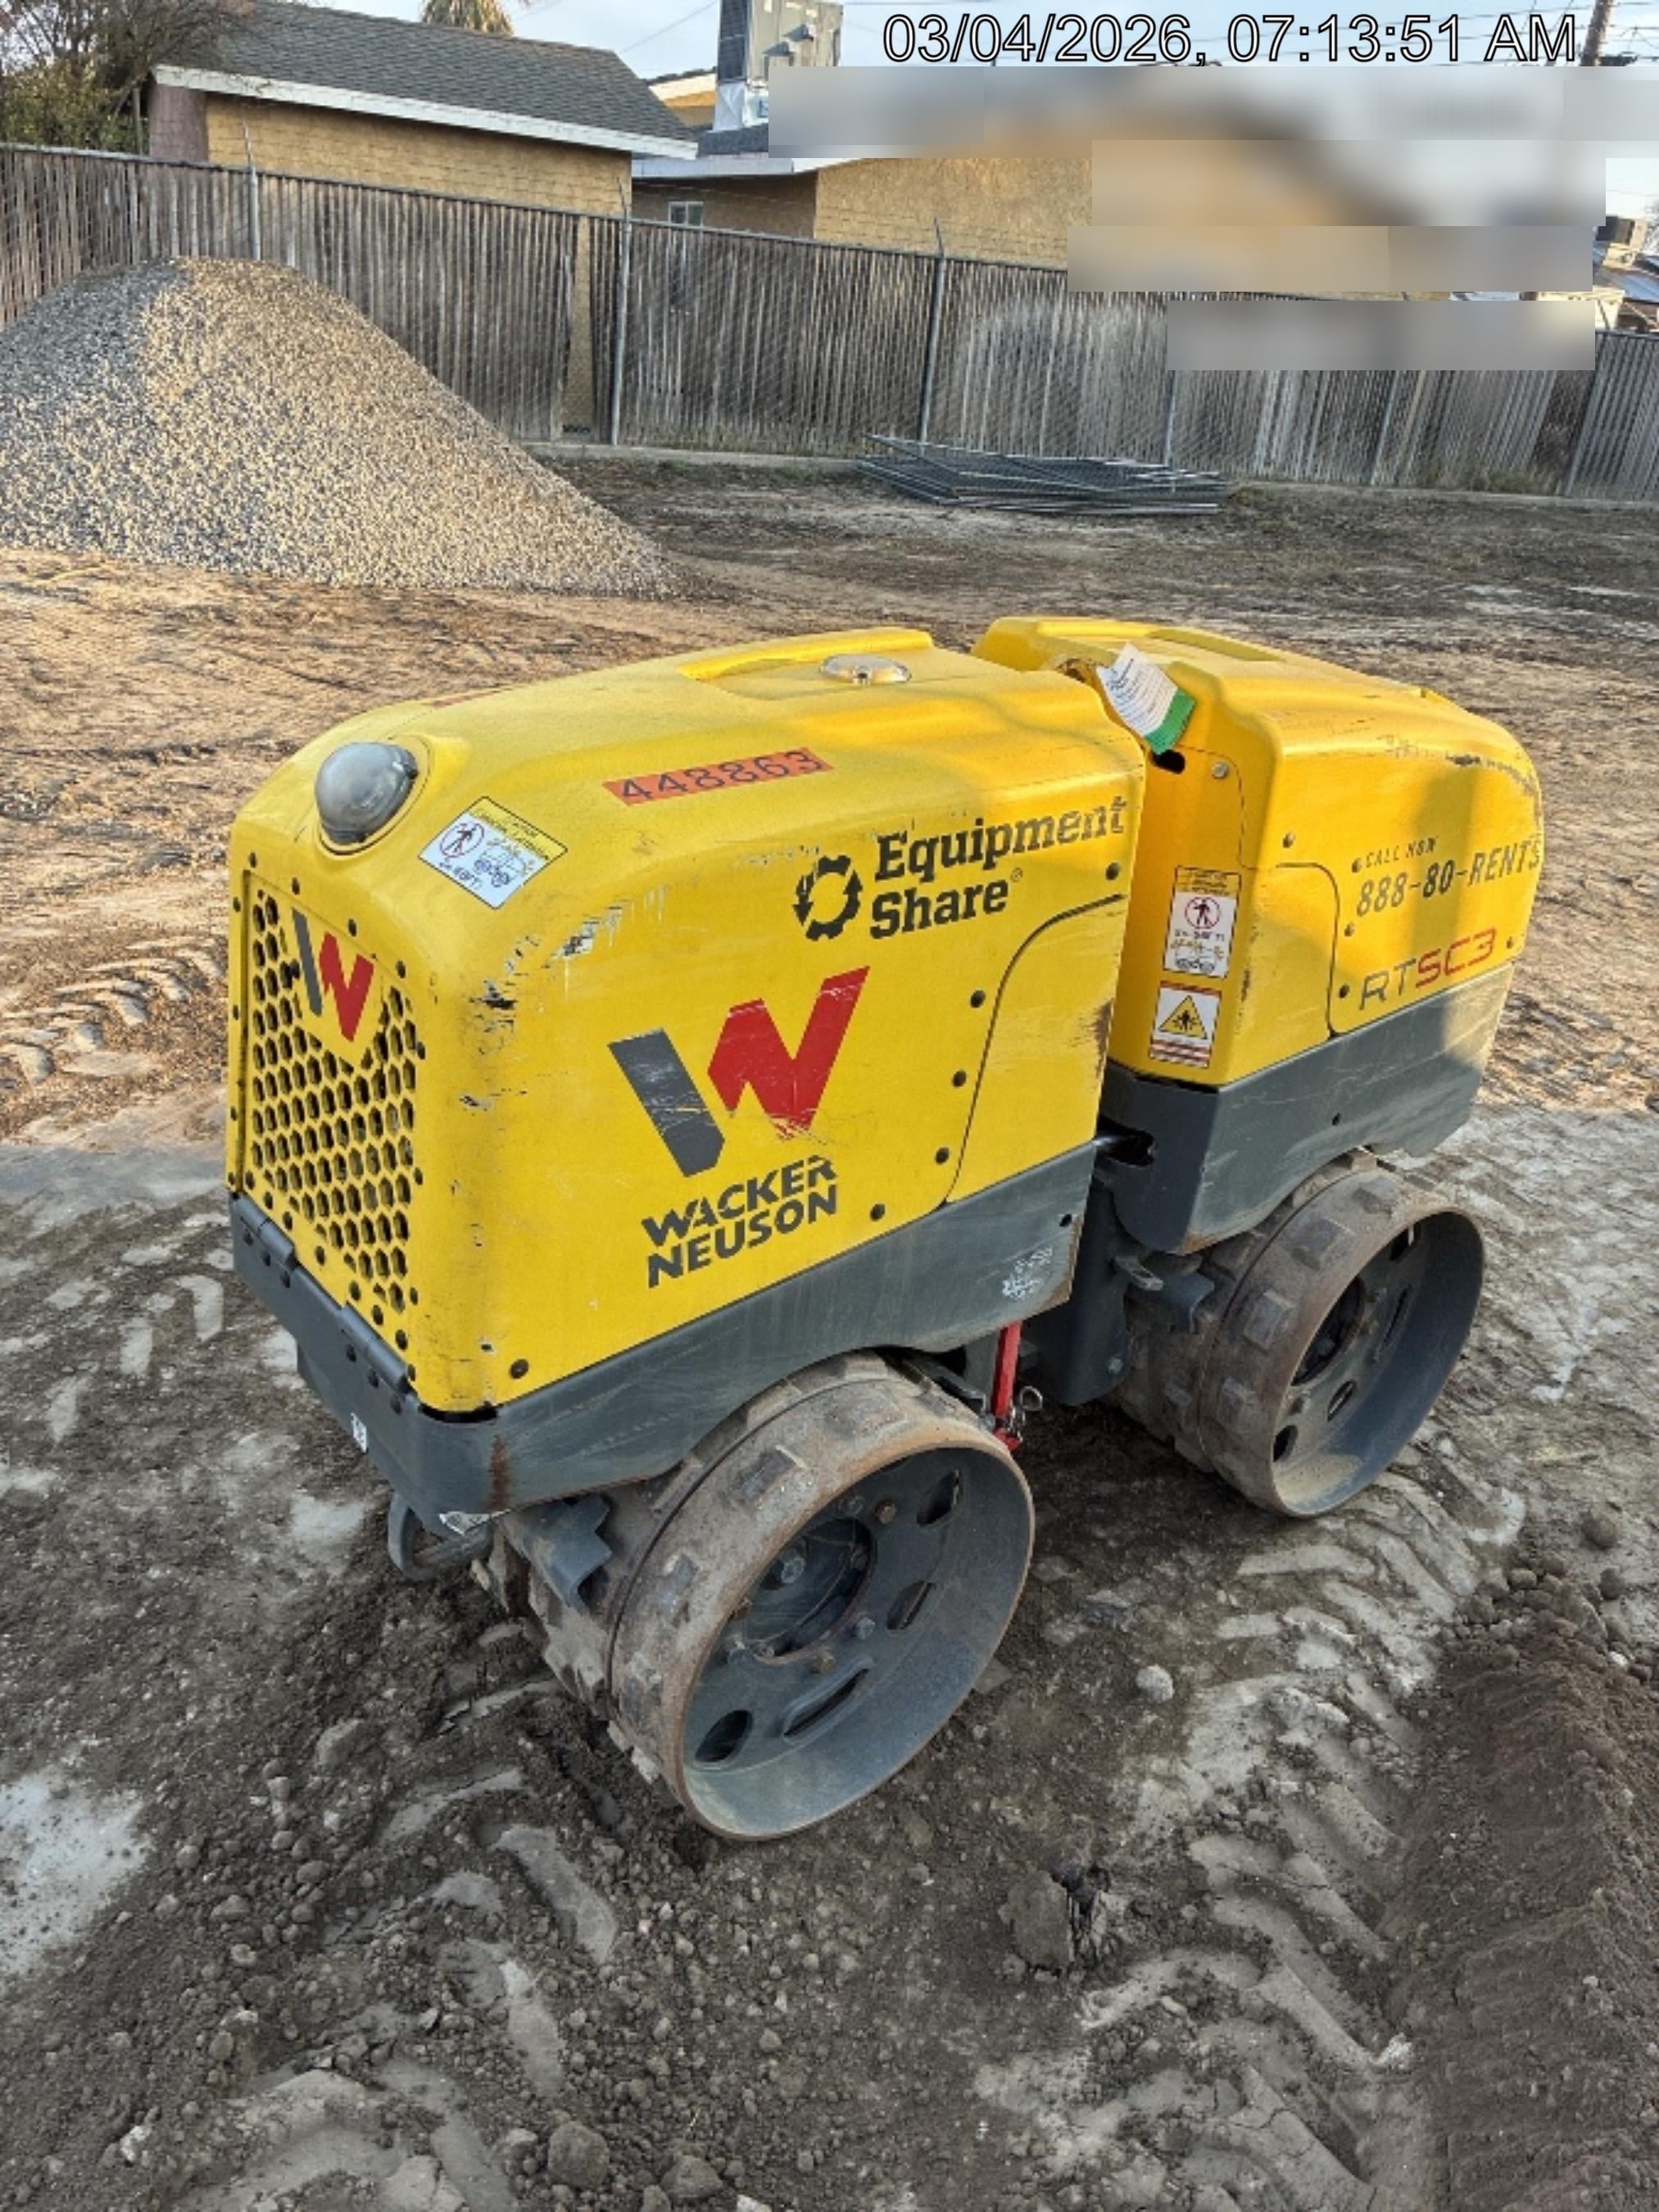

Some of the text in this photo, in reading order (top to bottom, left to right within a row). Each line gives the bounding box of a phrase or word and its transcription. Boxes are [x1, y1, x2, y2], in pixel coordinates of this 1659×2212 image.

[623, 750, 823, 800] 448863
[874, 796, 1128, 883] Equipment
[1357, 835, 1543, 917] 888-80-RENTS
[1367, 845, 1399, 868] CALL
[1359, 927, 1496, 1010] RTSC3
[641, 1154, 837, 1247] WACKER
[647, 1185, 837, 1288] NEUSON
